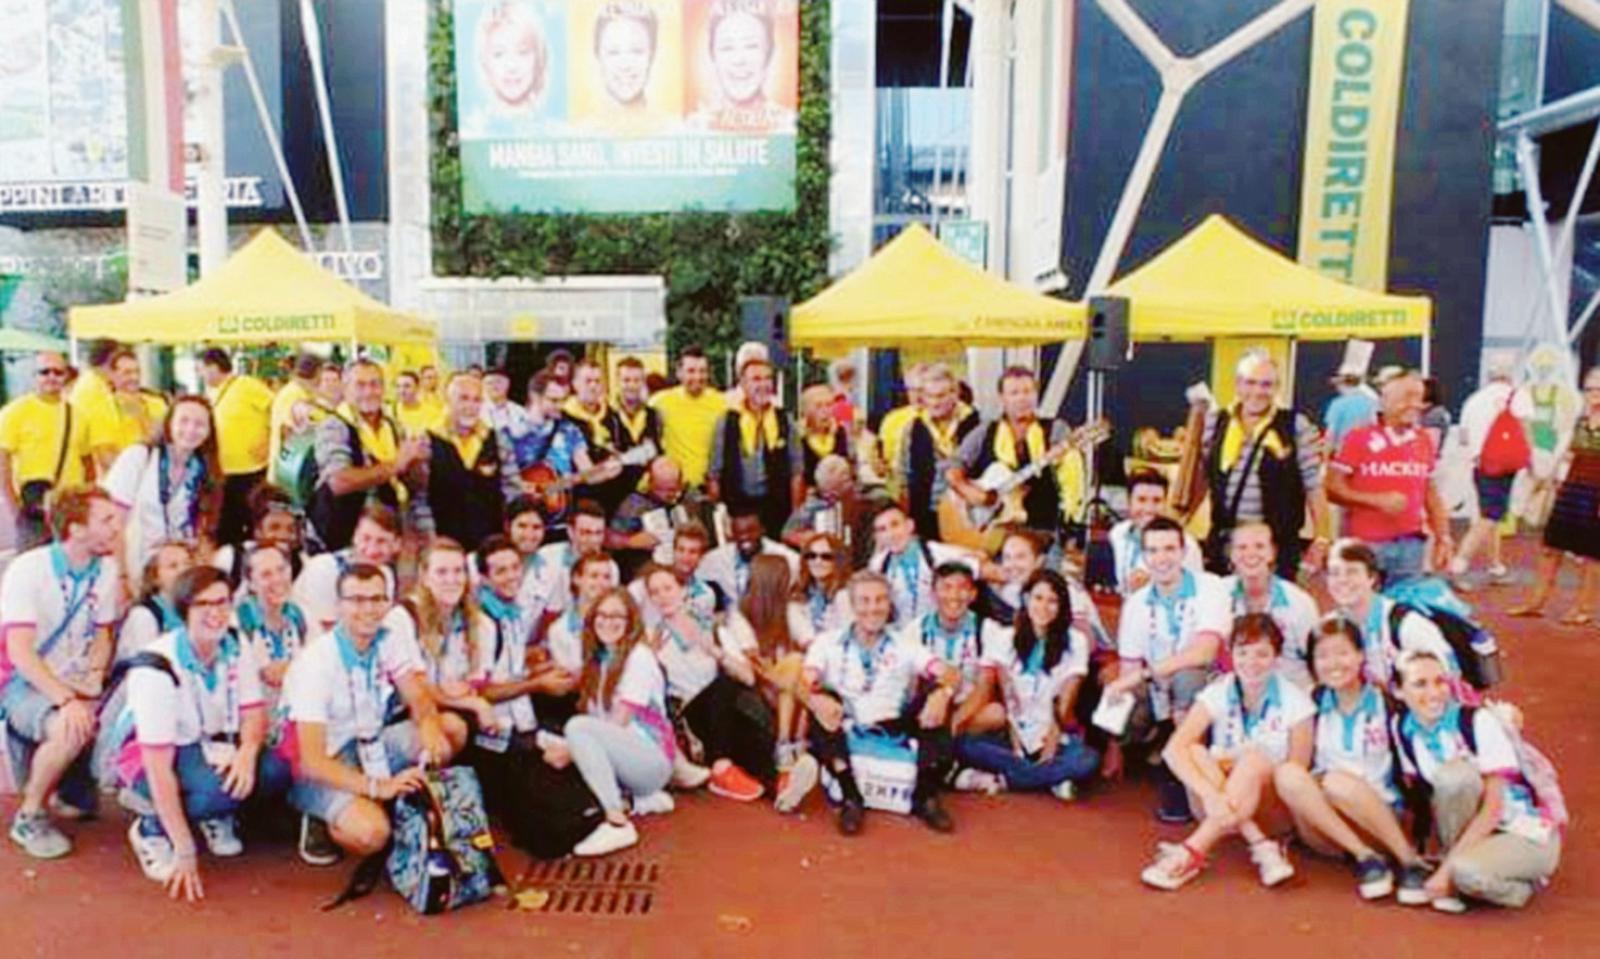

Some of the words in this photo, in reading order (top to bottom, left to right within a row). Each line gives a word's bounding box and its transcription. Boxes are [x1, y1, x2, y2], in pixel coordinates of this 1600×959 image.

[1319, 8, 1377, 284] COLDIRETT
[242, 315, 336, 333] COLDIRETTI
[1299, 308, 1407, 328] COLDIRETTI
